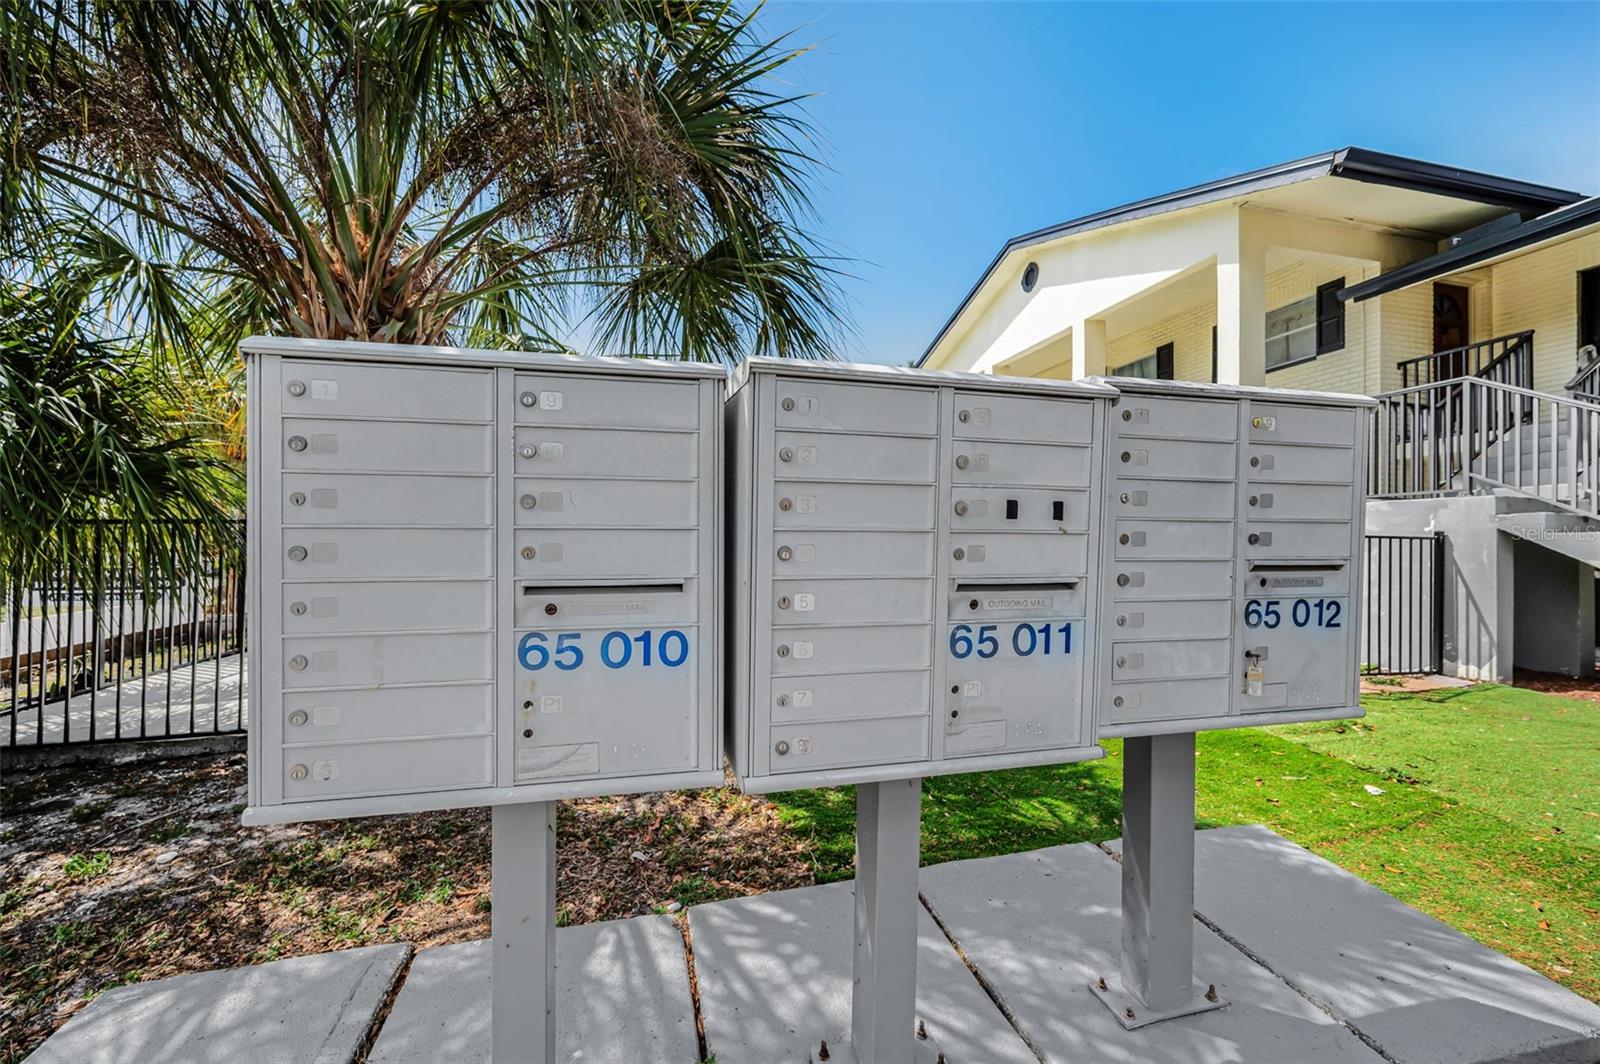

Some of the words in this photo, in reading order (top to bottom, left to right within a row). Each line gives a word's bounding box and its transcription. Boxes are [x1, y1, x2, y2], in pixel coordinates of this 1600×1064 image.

[546, 393, 557, 408] 9
[802, 448, 812, 462] 2
[801, 498, 810, 512] 3
[800, 595, 809, 609] 5
[988, 599, 1029, 608] OUTGOING
[1030, 598, 1047, 608] MAIL
[1244, 599, 1281, 629] 65
[1292, 598, 1342, 628] 012
[949, 624, 999, 659] 65
[1012, 622, 1072, 657] 011
[517, 631, 584, 671] 65
[600, 629, 689, 669] 010
[797, 691, 807, 704] 7
